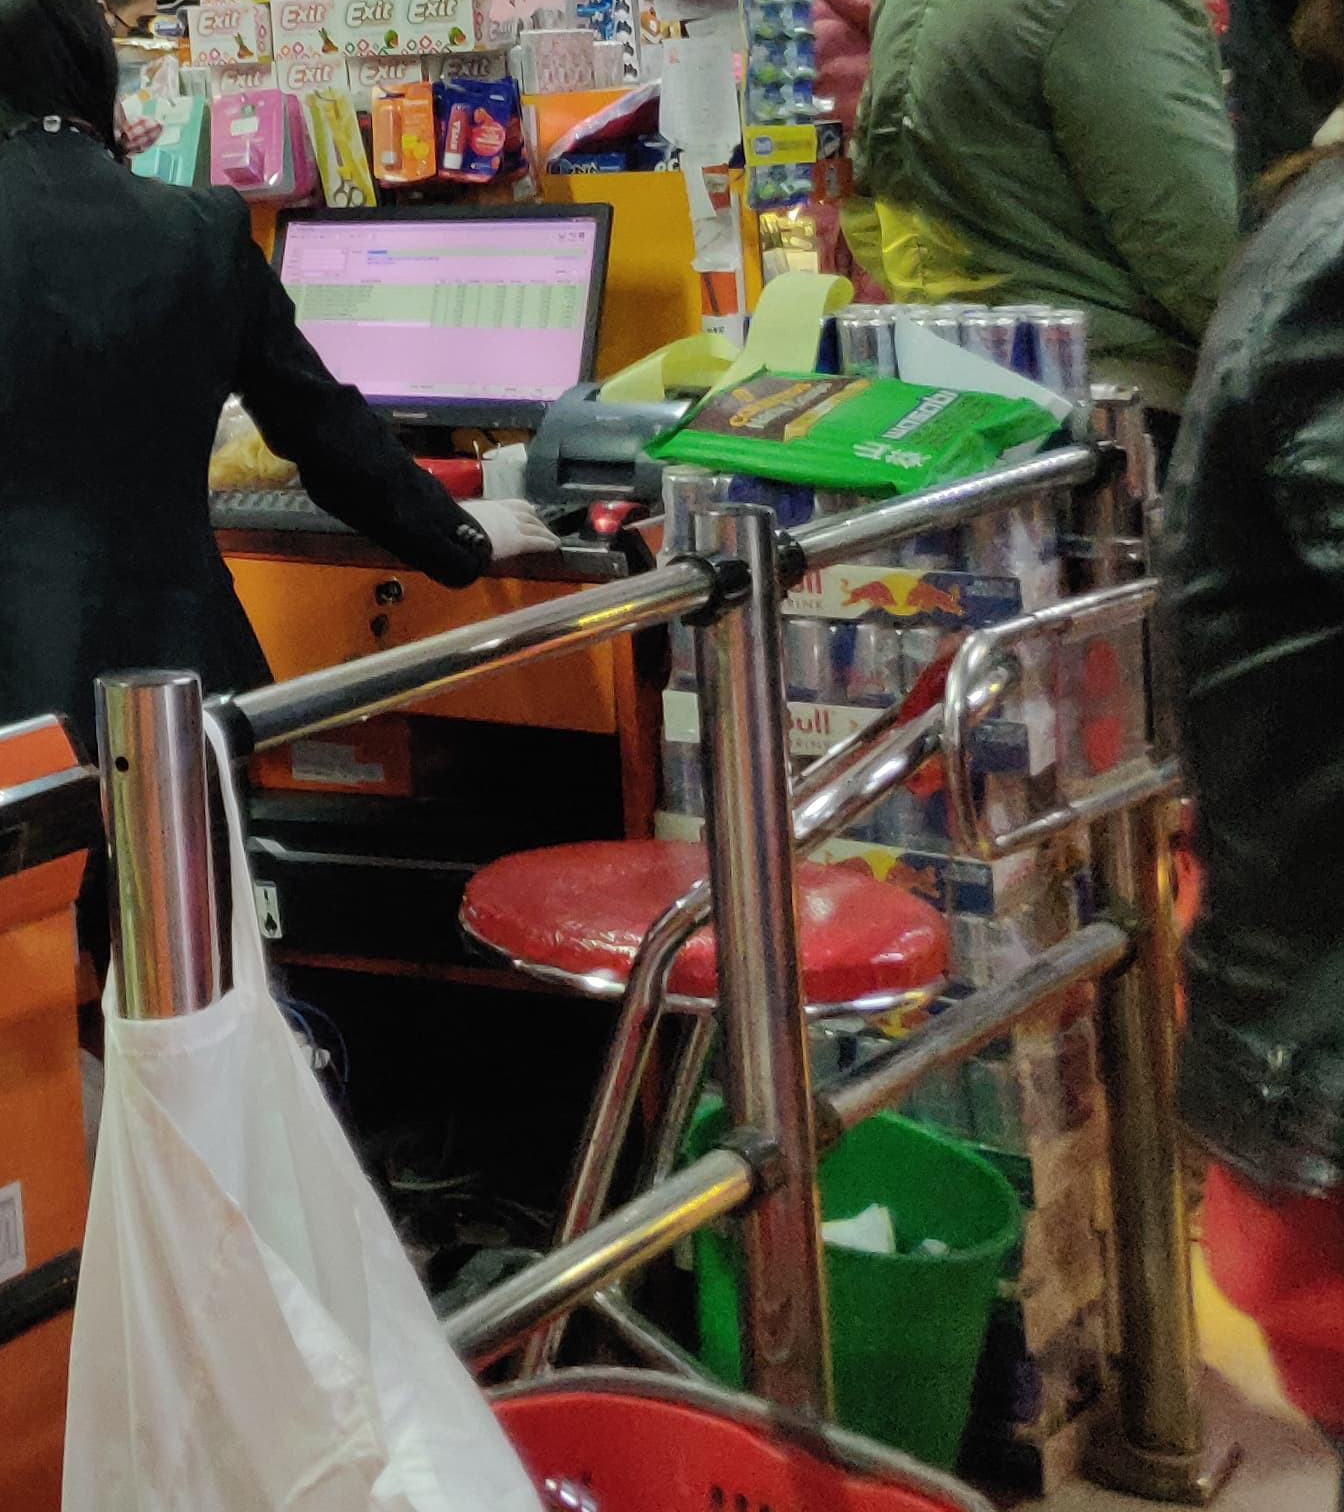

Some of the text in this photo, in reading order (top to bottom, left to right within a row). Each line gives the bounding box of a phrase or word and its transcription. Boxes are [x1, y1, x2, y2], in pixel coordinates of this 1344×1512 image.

[198, 10, 241, 36] Exit
[281, 4, 327, 30] Exit
[287, 61, 334, 87] Exit
[788, 568, 823, 596] ull
